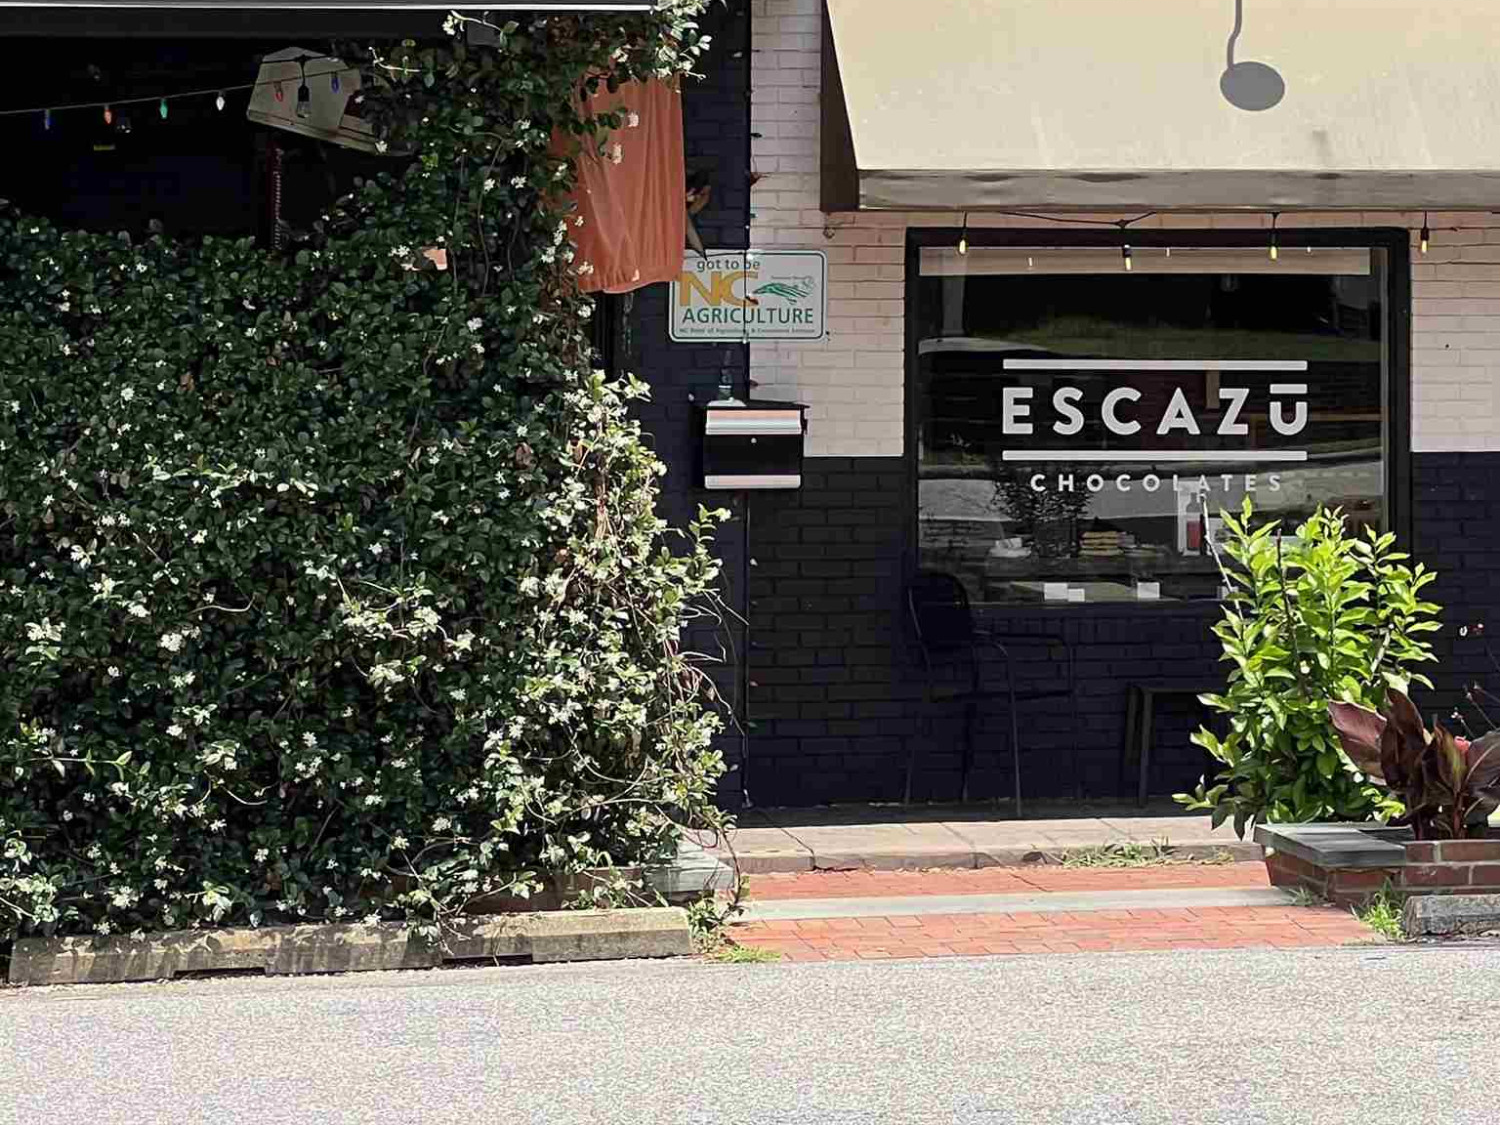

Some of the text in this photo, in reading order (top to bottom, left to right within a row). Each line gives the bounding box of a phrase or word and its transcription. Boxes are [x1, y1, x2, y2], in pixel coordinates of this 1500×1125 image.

[697, 259, 721, 272] got
[725, 259, 739, 270] to
[679, 271, 758, 306] NC
[682, 307, 814, 324] AGRICULTURE
[1030, 474, 1281, 492] CHOCOLATES
